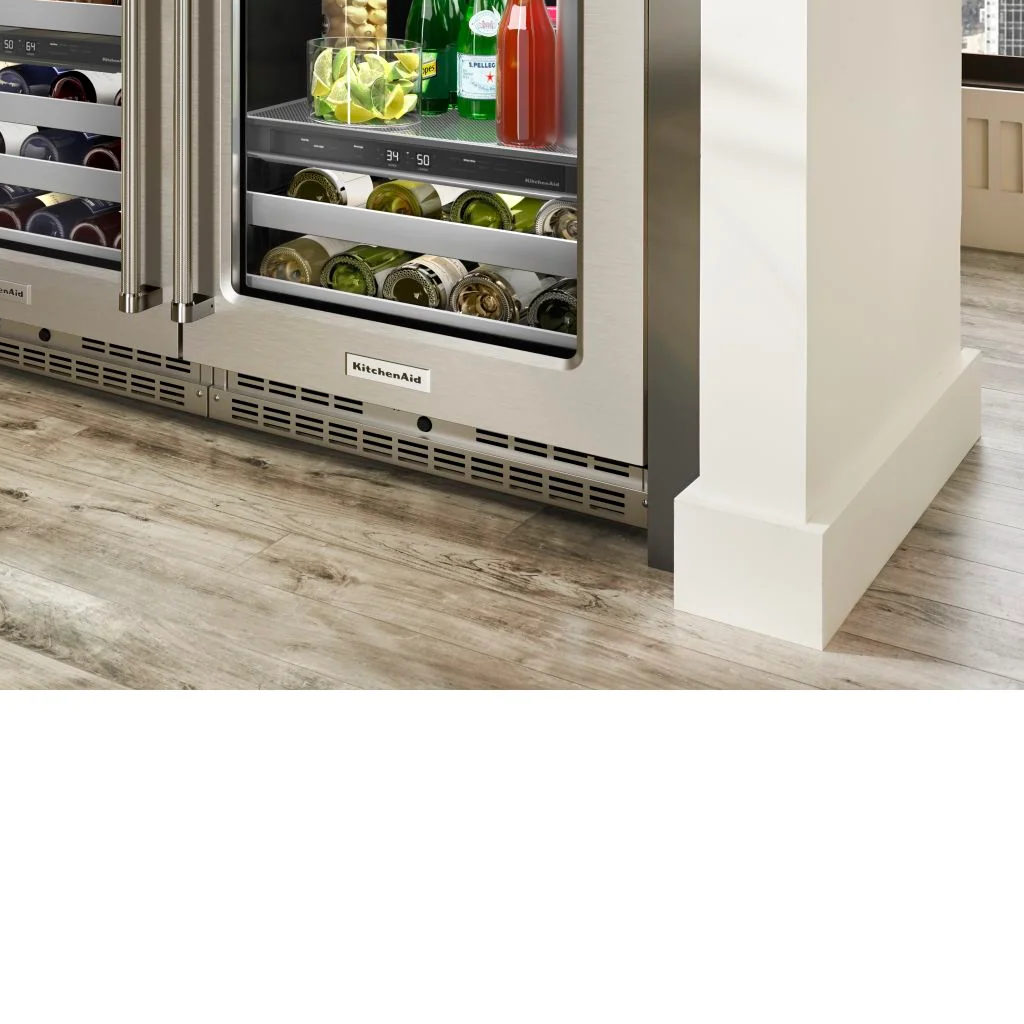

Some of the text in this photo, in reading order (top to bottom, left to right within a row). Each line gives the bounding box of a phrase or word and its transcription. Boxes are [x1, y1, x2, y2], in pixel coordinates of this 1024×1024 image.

[4, 39, 14, 50] 50
[25, 41, 36, 52] 64
[386, 149, 399, 162] 34
[416, 153, 430, 166] 50
[352, 361, 422, 385] KitchenAid
